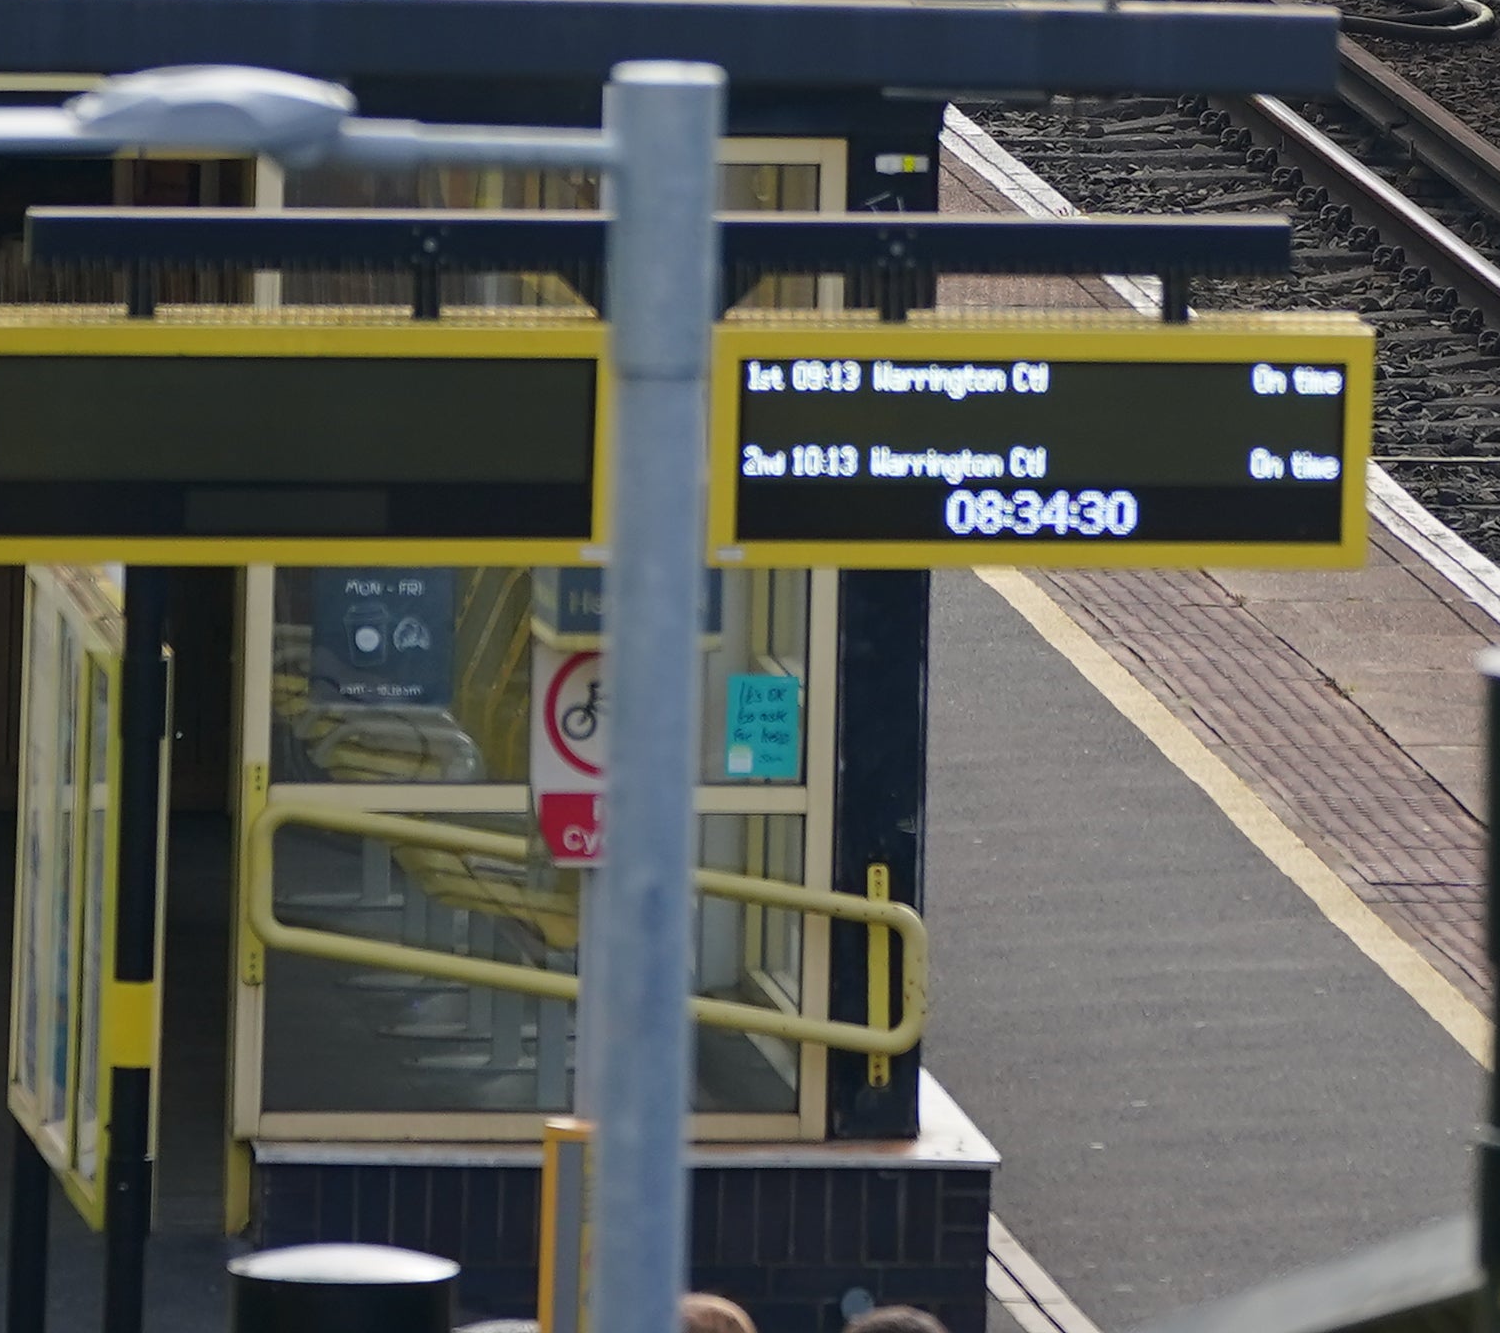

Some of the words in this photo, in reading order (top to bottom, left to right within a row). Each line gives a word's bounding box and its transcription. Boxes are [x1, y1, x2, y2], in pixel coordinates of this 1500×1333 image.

[747, 360, 786, 392] 1st
[792, 360, 862, 392] 09:13
[873, 360, 1008, 400] Warrington
[1252, 363, 1288, 395] On
[1293, 364, 1343, 397] time
[742, 444, 787, 476] 2nd
[792, 444, 860, 477] 10:13
[870, 445, 1005, 485] Warrington
[1249, 447, 1285, 479] On
[1290, 448, 1341, 481] time
[945, 488, 1139, 536] 08:34:30
[345, 580, 382, 596] MON
[398, 579, 424, 596] FRI
